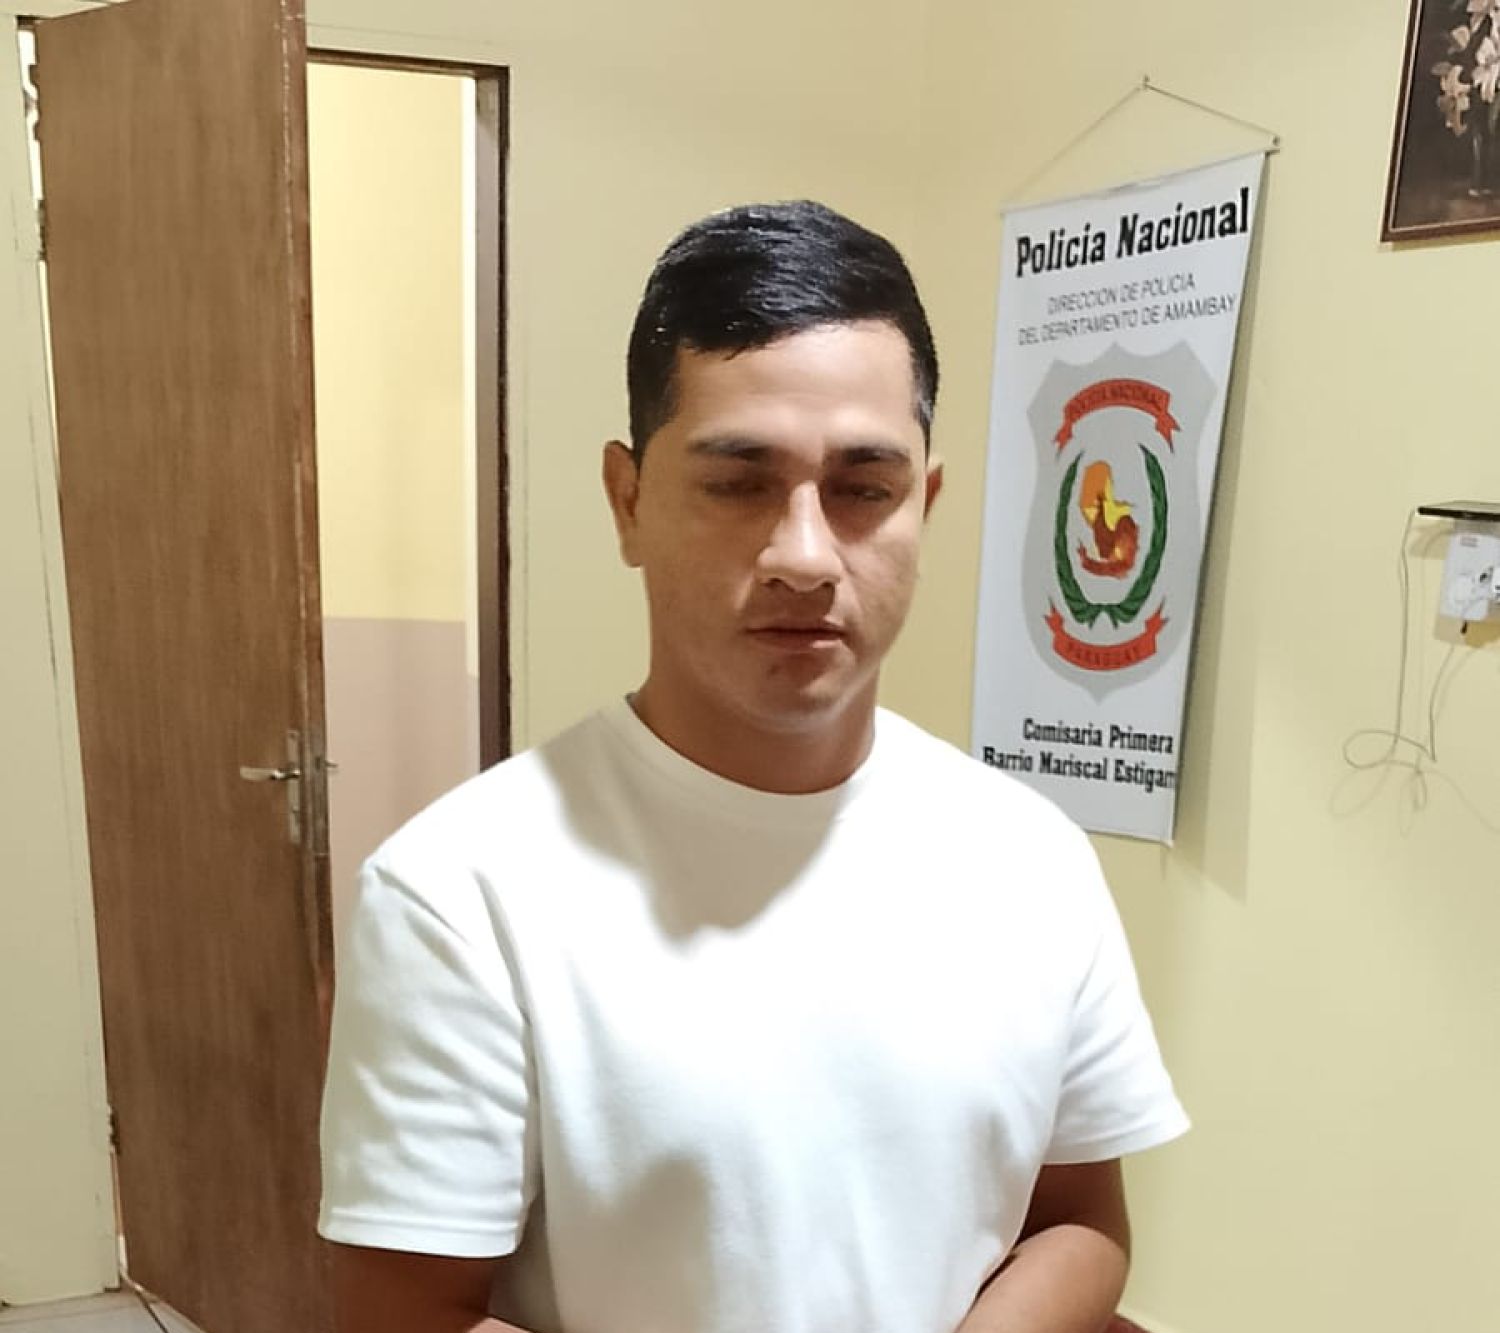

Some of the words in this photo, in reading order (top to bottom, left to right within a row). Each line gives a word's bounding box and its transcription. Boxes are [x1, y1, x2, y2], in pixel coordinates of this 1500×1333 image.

[1016, 222, 1106, 278] Policia
[1116, 187, 1249, 259] Nacional
[1120, 282, 1140, 302] DE
[1042, 308, 1138, 341] DEPARTAMENTO
[1141, 304, 1161, 325] DE
[1163, 293, 1236, 320] AMAMBAY
[1023, 717, 1102, 747] Comisaria
[1109, 724, 1173, 754] Primera
[983, 746, 1033, 772] Barrio
[1039, 751, 1108, 781] Mariscal
